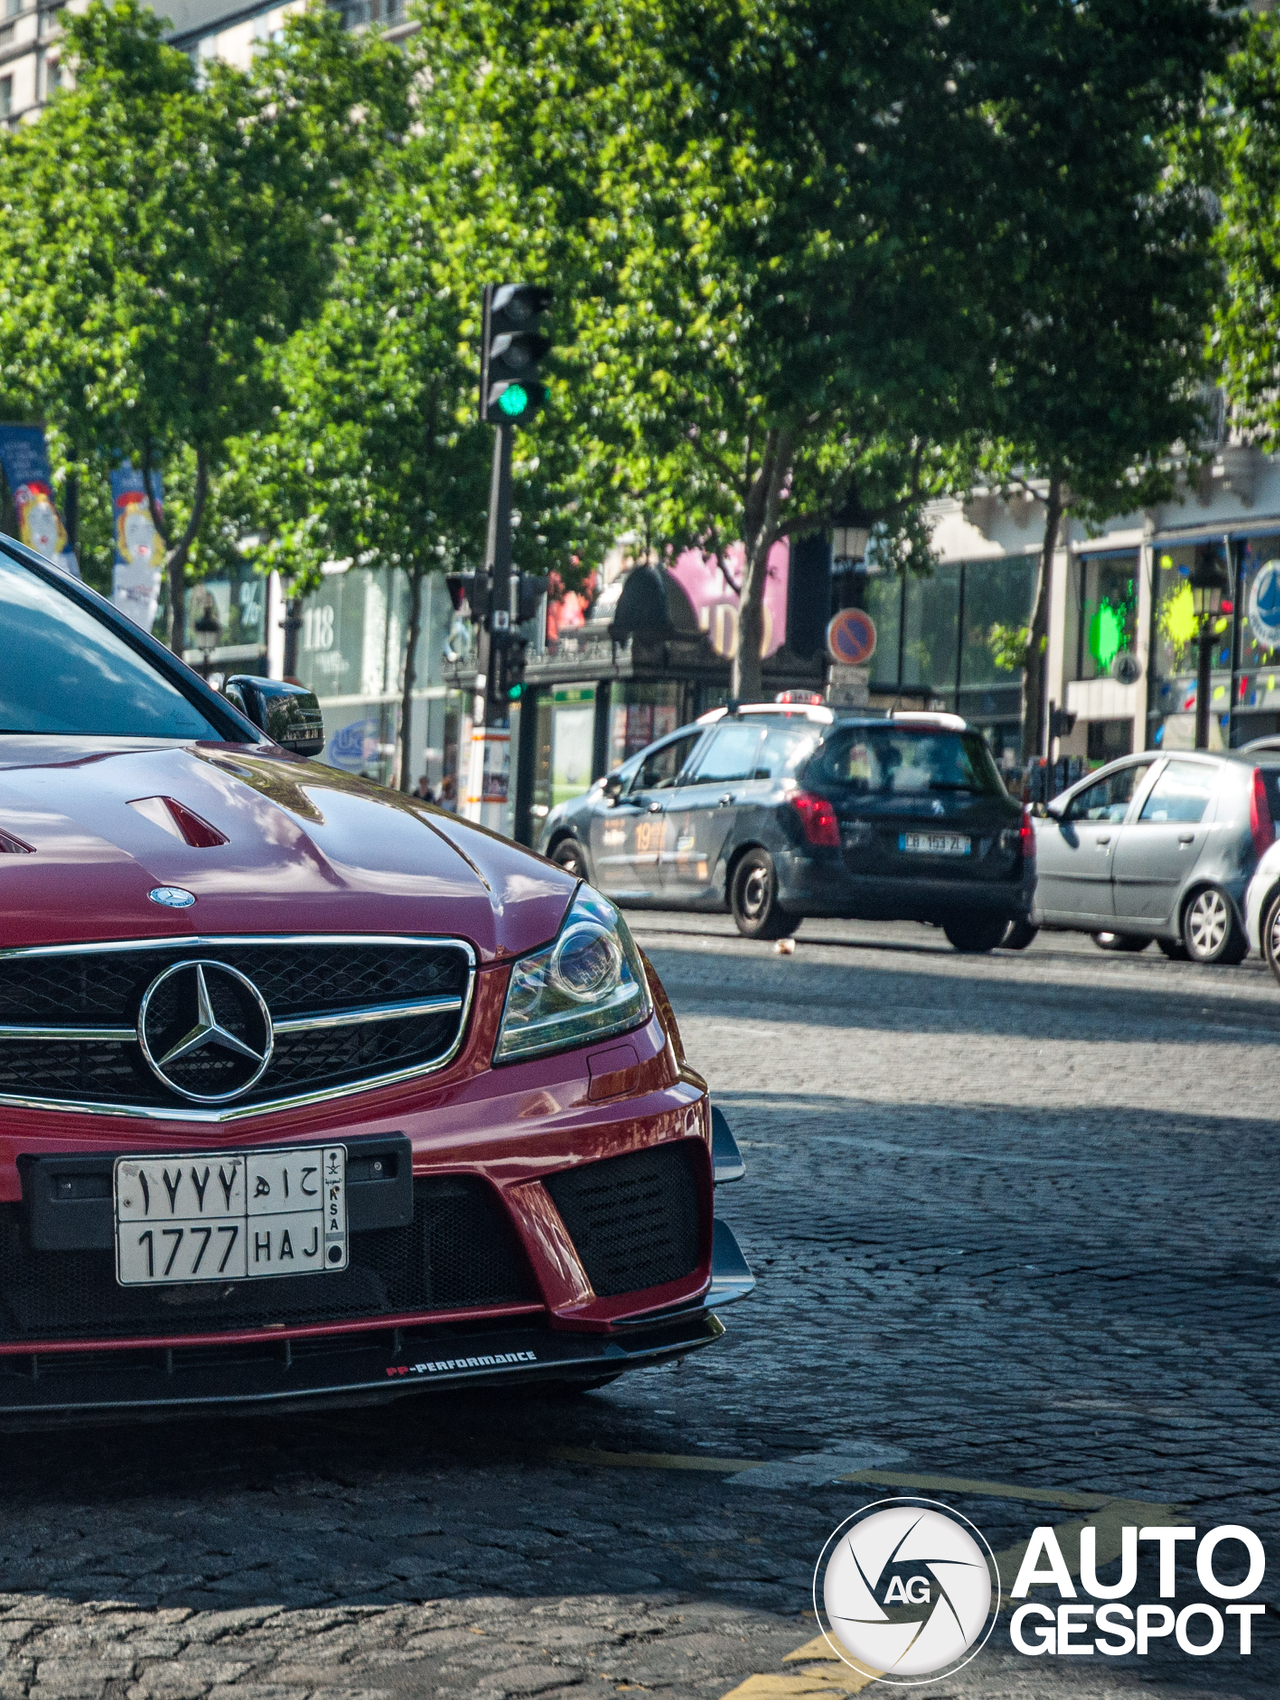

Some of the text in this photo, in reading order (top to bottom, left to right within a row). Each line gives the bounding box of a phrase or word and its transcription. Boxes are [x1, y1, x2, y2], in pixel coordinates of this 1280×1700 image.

[303, 604, 335, 652] 118
[138, 1164, 237, 1216] ١٧٧٧
[329, 1187, 339, 1231] KSA
[138, 1225, 239, 1277] 1777
[255, 1226, 319, 1263] HAJ
[385, 1350, 538, 1377] PP-PERFORMANCE
